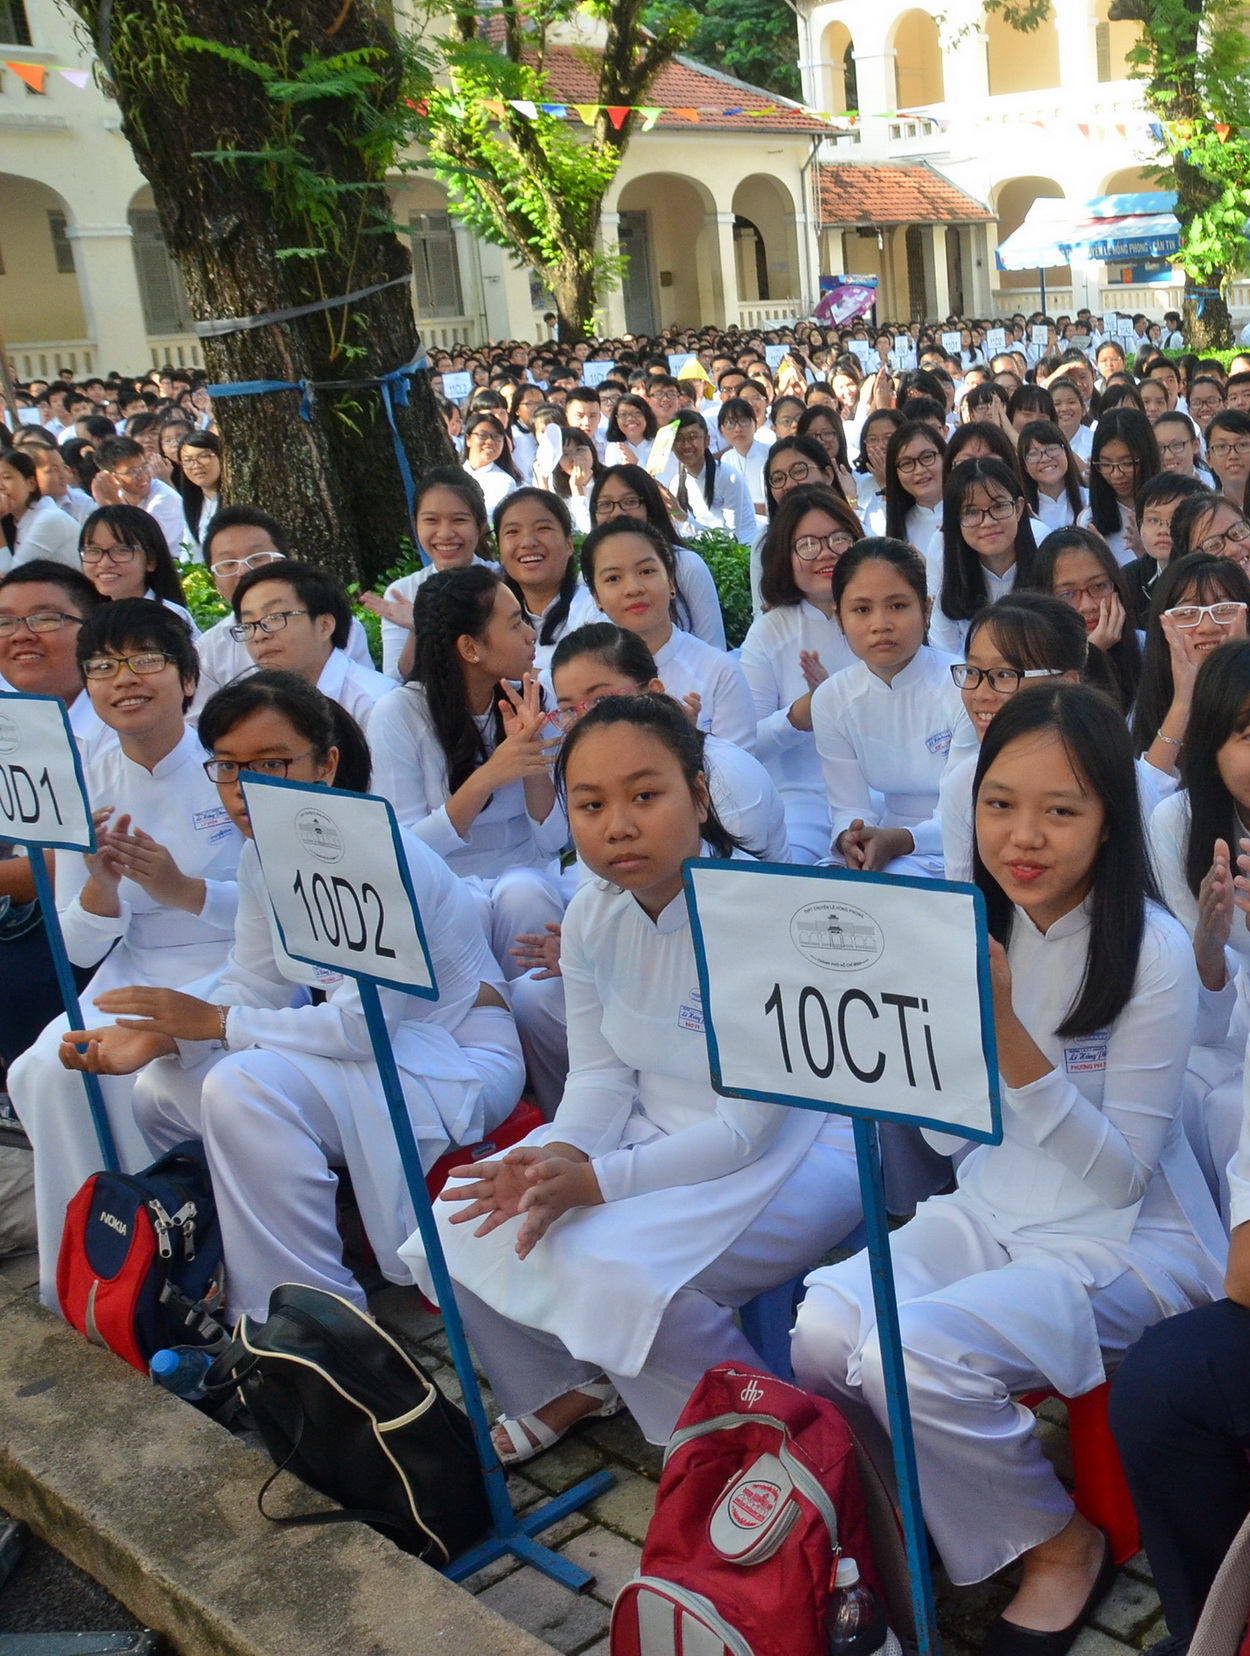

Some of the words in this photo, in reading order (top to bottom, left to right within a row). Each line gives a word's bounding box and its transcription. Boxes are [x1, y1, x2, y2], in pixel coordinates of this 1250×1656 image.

[293, 869, 397, 959] 10D2
[764, 983, 942, 1092] 10CTi
[100, 1211, 127, 1236] NOKIA
